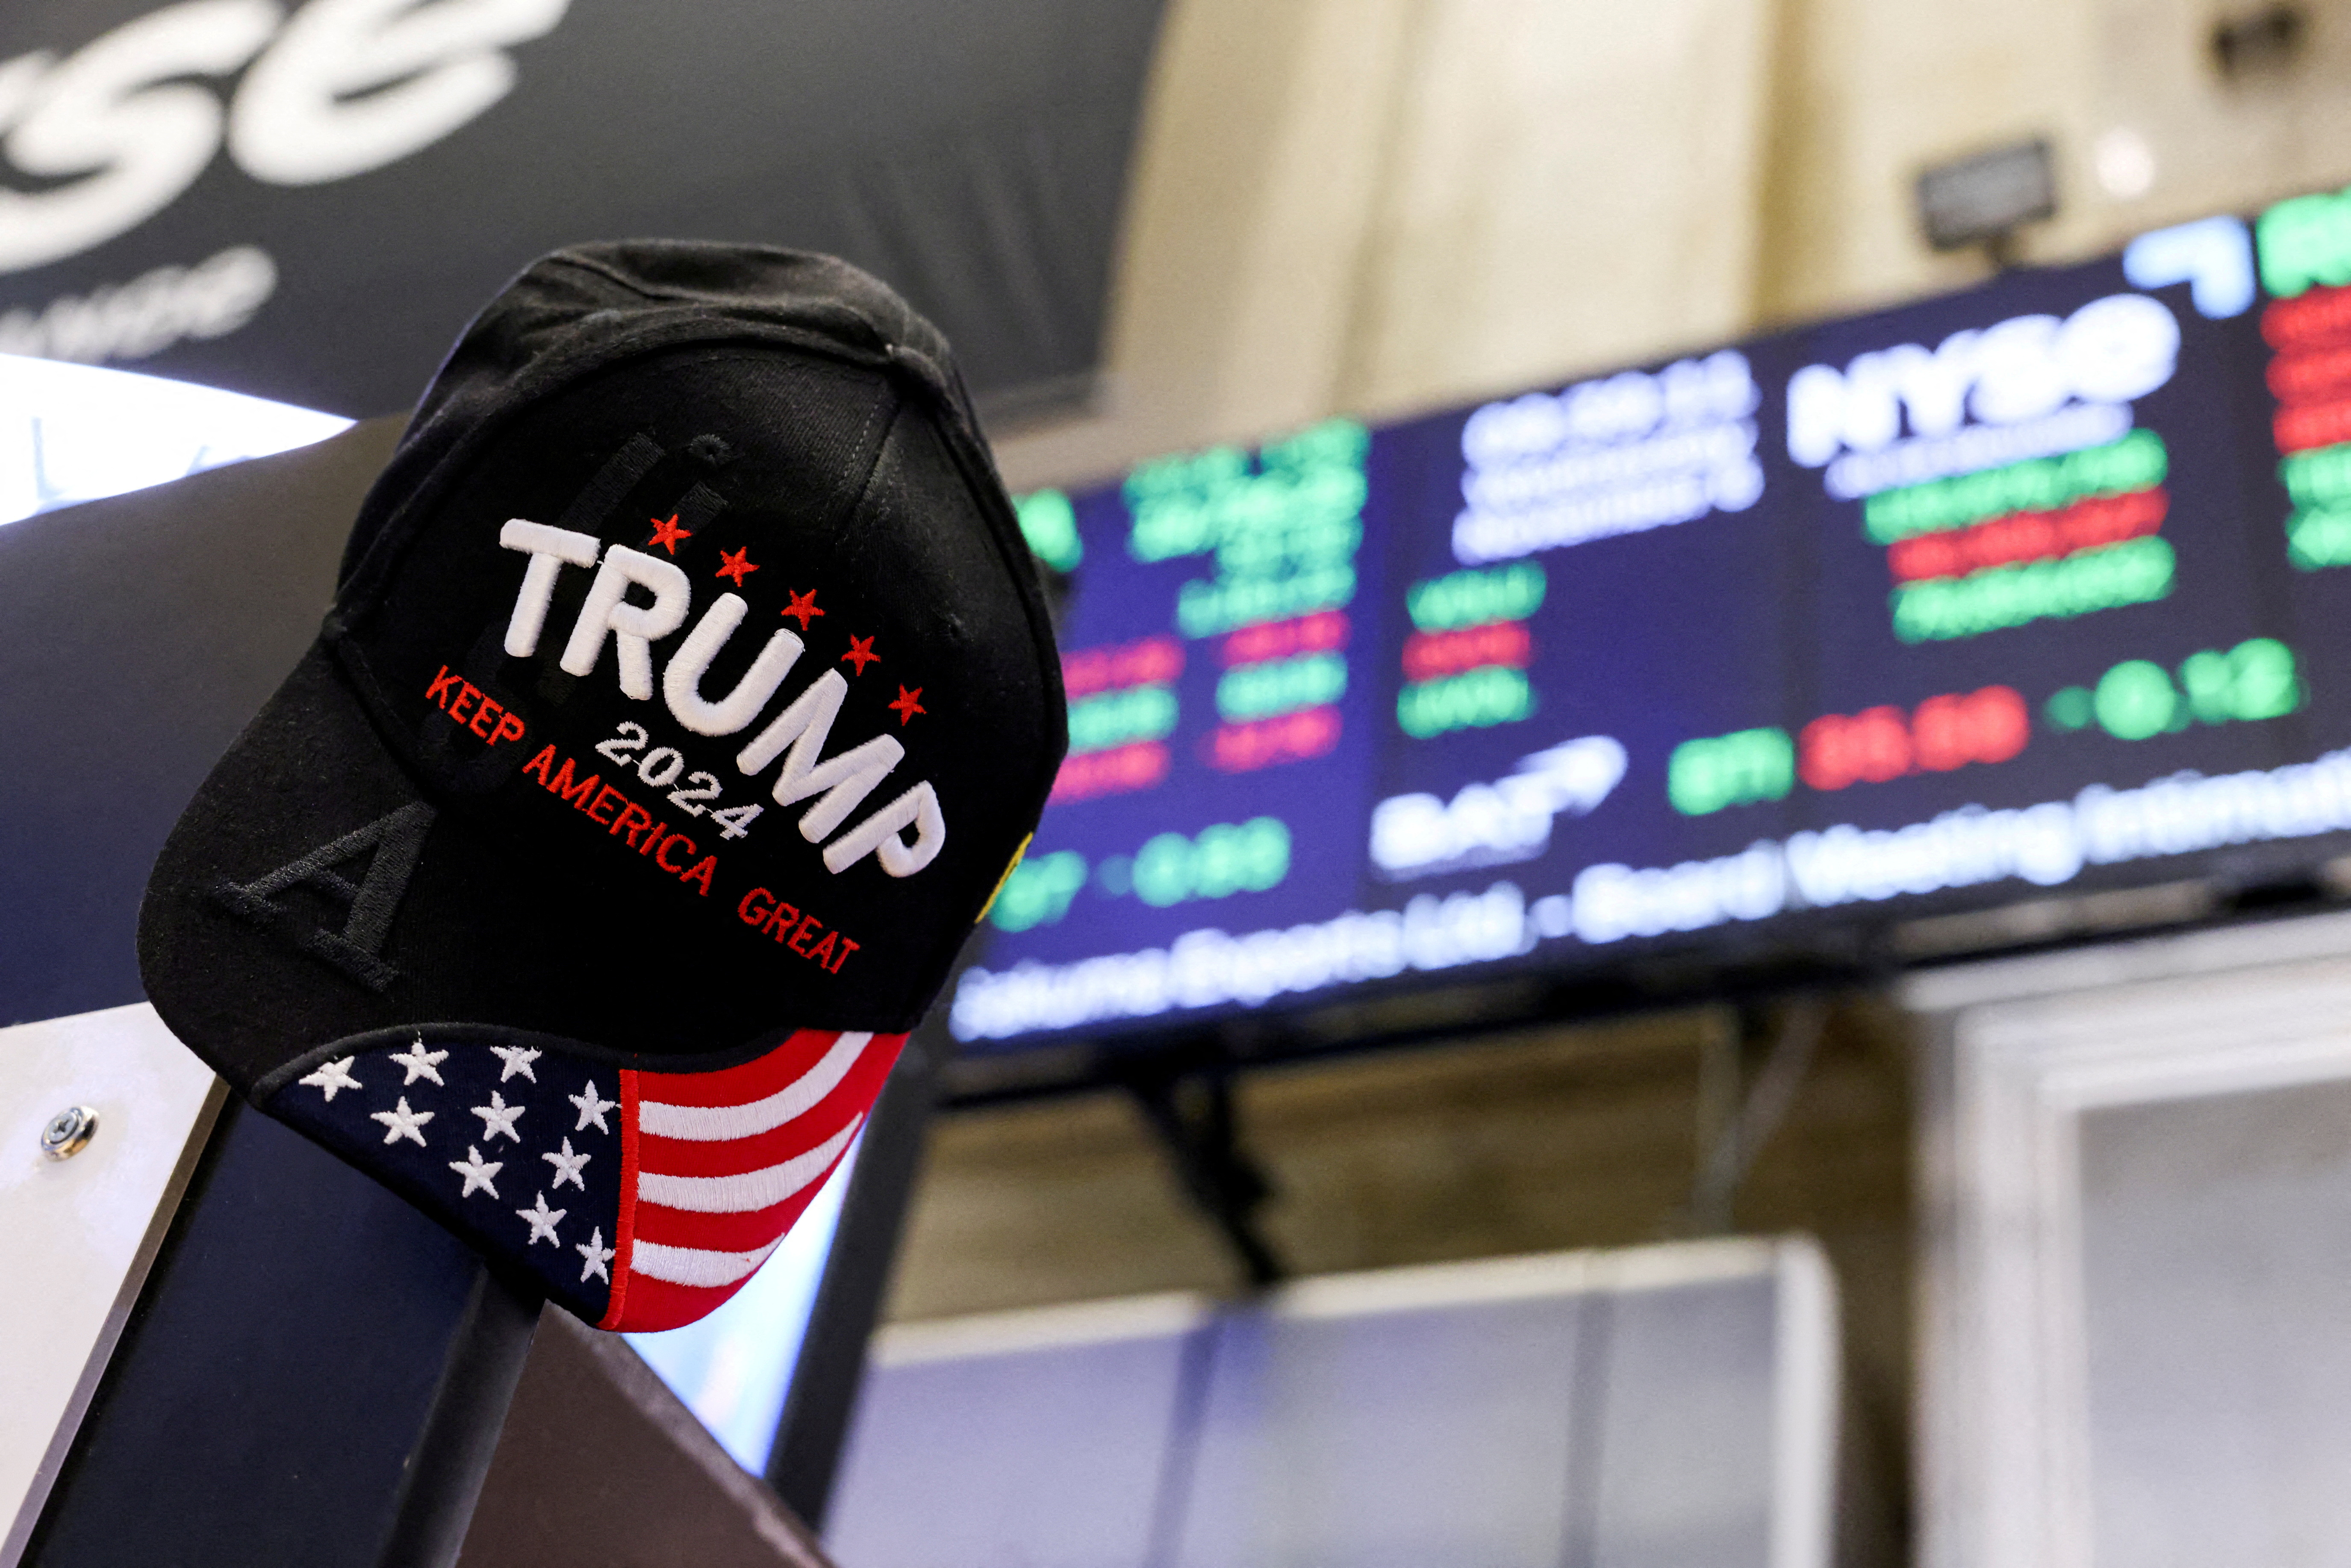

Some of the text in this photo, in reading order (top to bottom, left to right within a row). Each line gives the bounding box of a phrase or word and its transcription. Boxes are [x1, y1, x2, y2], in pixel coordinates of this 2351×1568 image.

[424, 664, 860, 975] KEEP AMERICA GREAT
[499, 518, 946, 878] TRUMP
[595, 720, 765, 841] 2024
